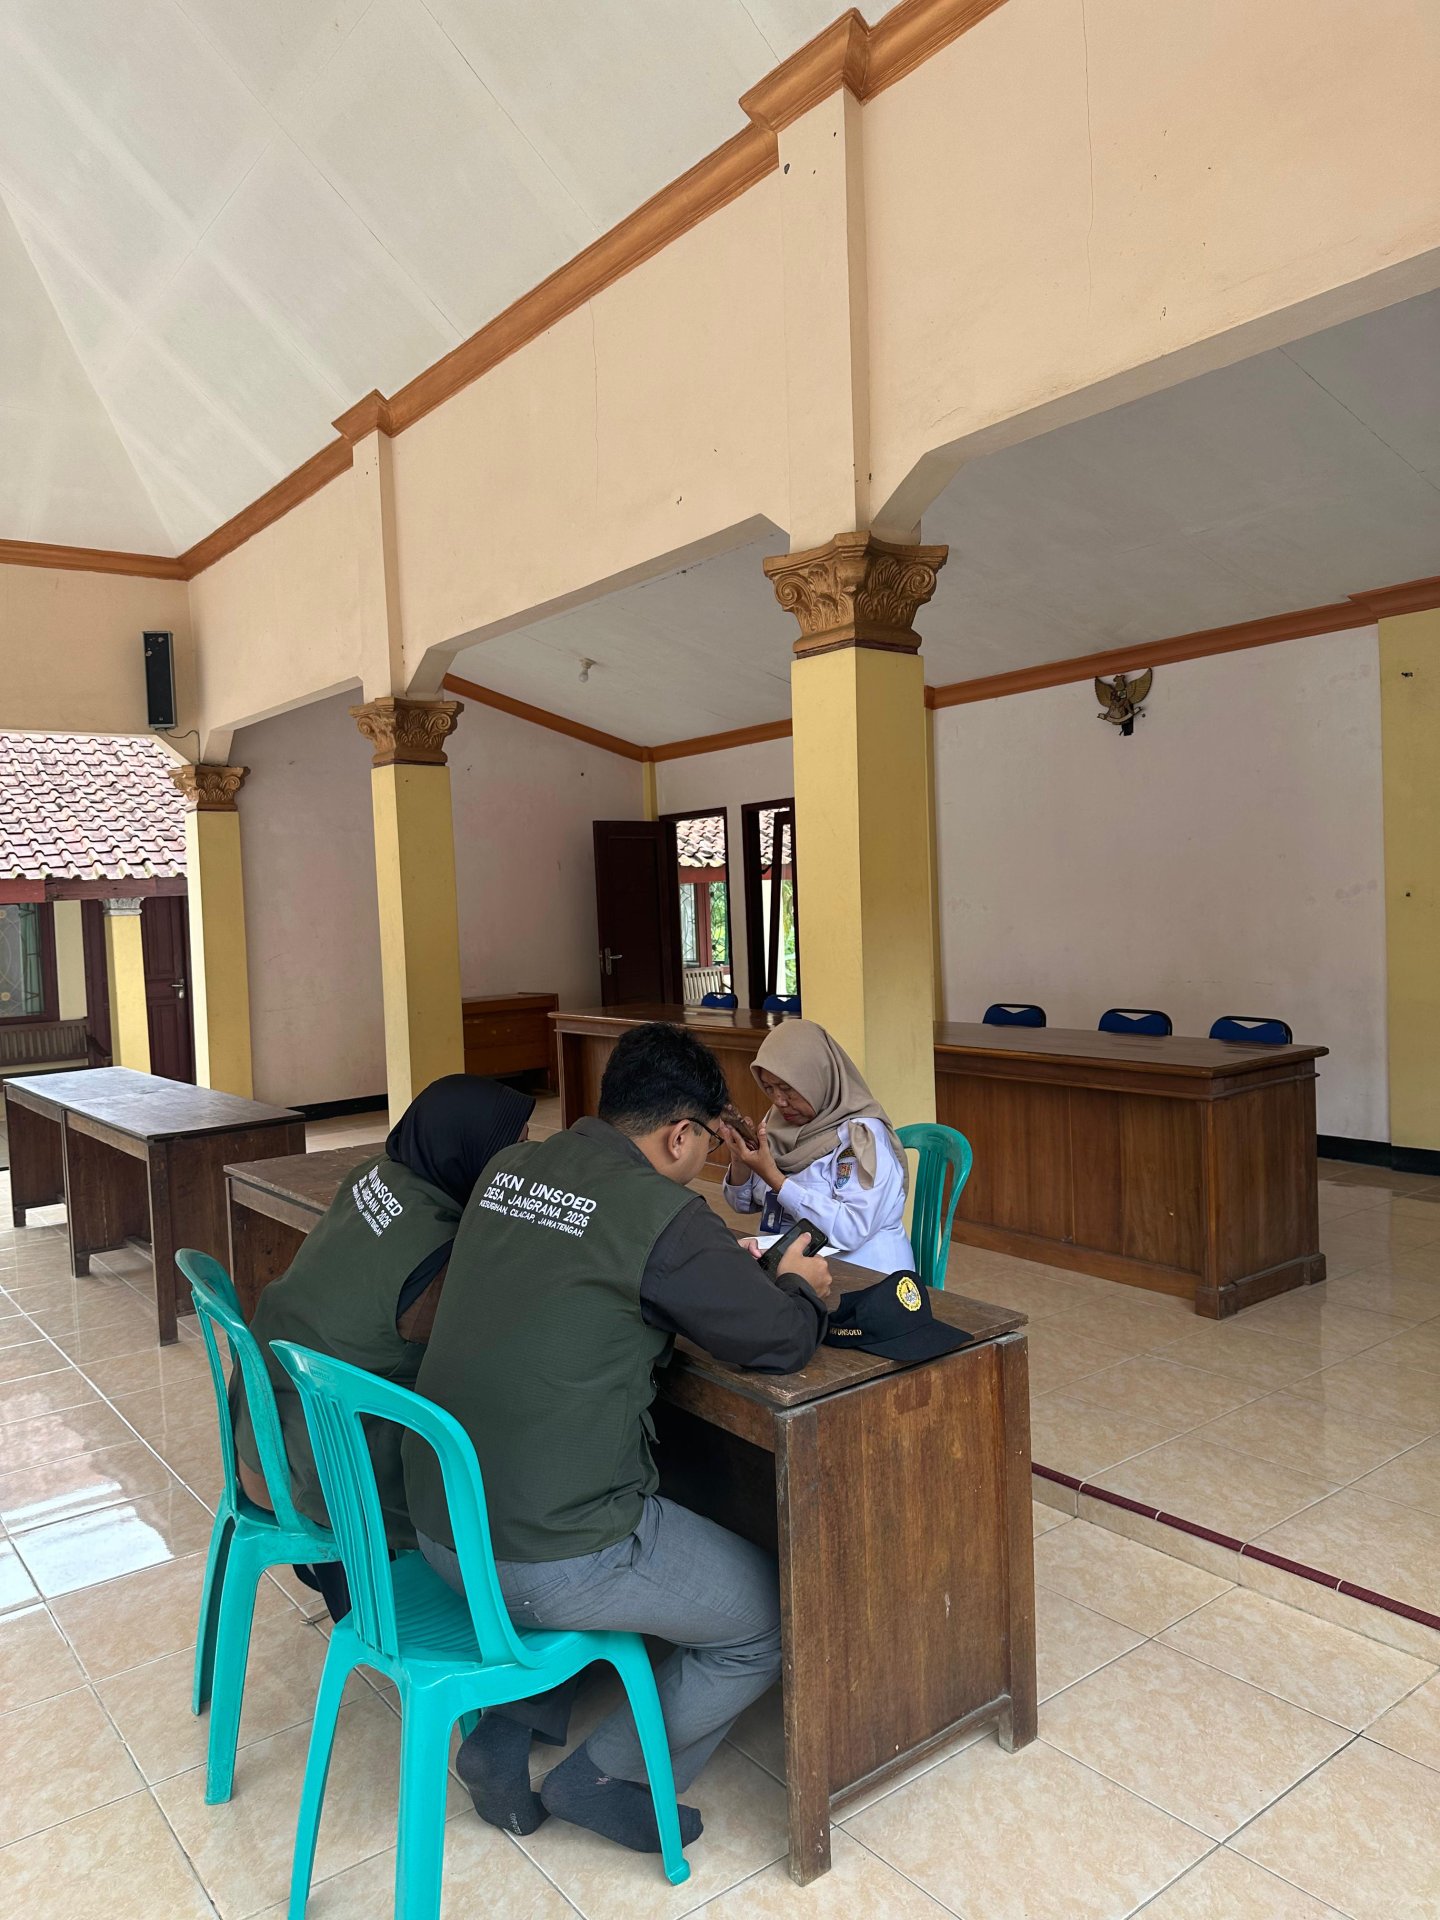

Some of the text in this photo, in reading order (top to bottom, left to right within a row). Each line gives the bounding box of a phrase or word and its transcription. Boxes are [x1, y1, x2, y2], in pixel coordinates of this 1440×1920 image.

[371, 1176, 403, 1216] UNSOED
[483, 1187, 590, 1228] DESA JANGRANA 2026
[491, 1172, 597, 1213] KKN UNSOED
[376, 1210, 392, 1228] 2026
[509, 1208, 536, 1224] CILACAP,
[537, 1217, 584, 1238] JAWATENGAH
